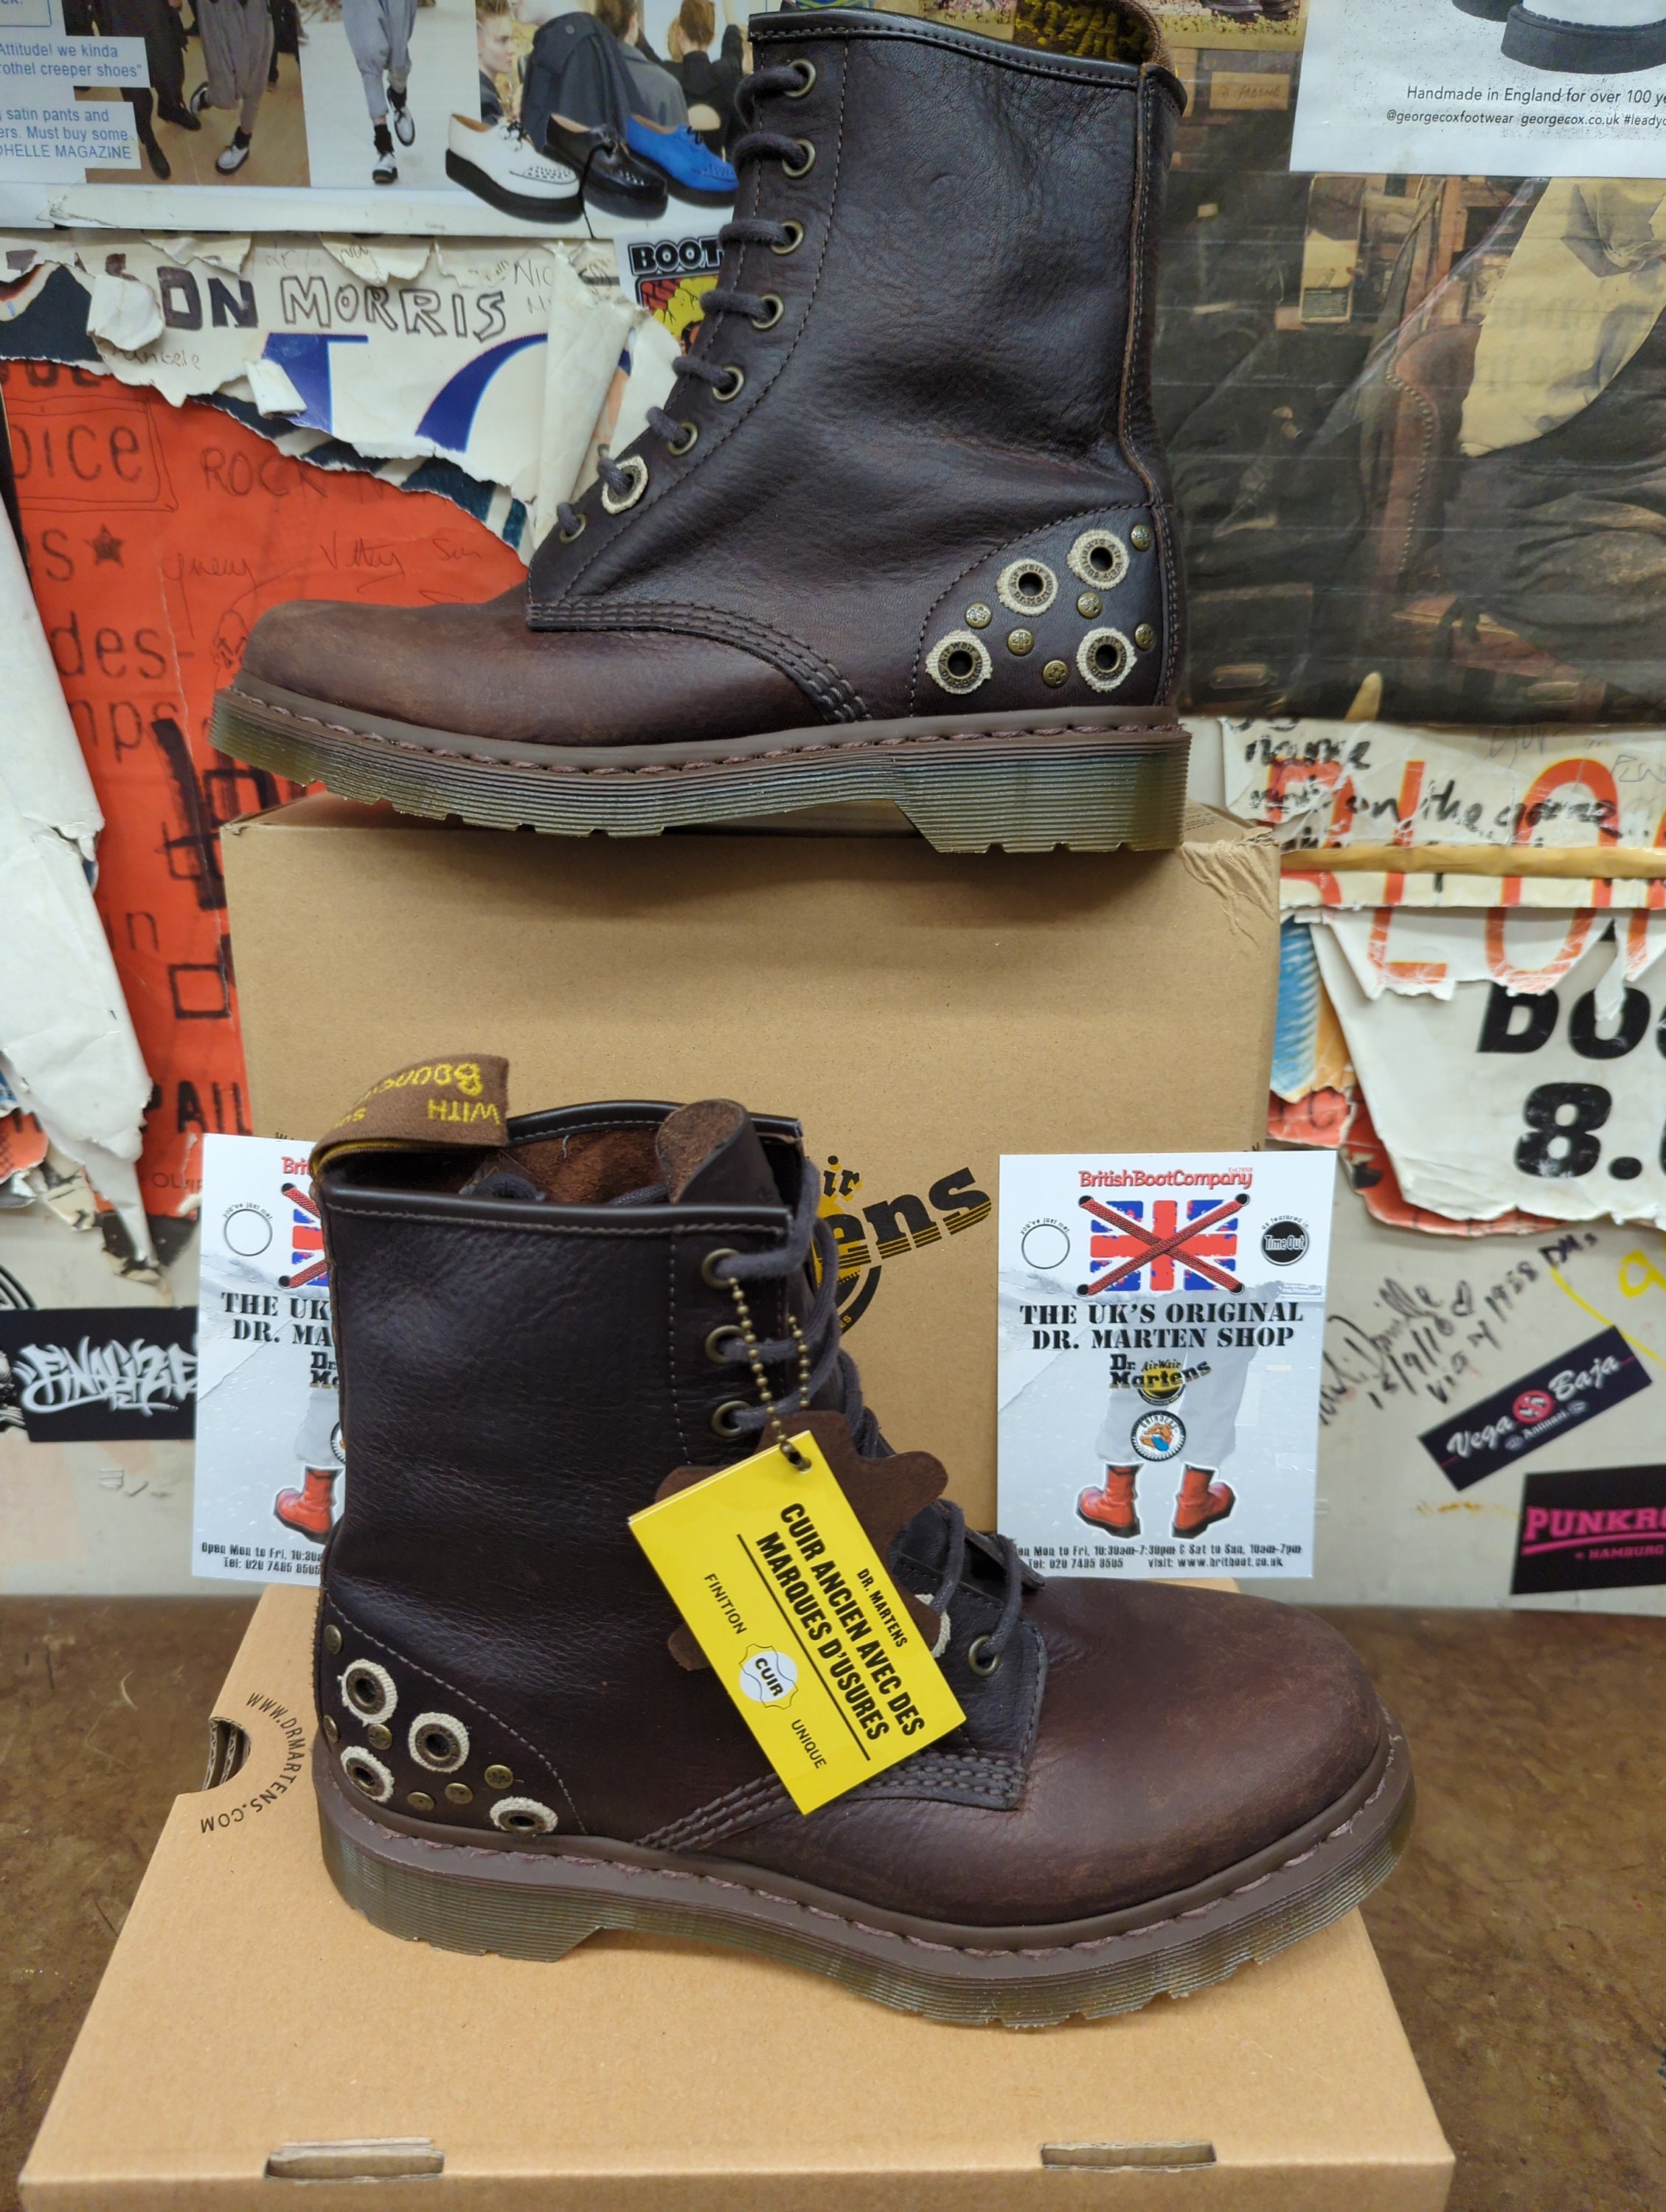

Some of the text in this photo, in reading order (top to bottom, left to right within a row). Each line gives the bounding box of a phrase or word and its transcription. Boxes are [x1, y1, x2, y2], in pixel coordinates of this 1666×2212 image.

[58, 47, 77, 56] we
[81, 44, 118, 58] kinda
[0, 63, 35, 75] othel
[41, 64, 91, 78] creeper
[1406, 86, 1482, 100] Handmade
[1487, 87, 1499, 101] in
[1504, 88, 1561, 105] England
[1566, 88, 1586, 102] for
[1590, 92, 1622, 103] over
[1627, 89, 1652, 103] 100
[7, 108, 109, 122] satin pants and
[1386, 109, 1513, 124] @georgecoxfootwear
[1521, 111, 1620, 127] georgecox.co.uk
[27, 126, 59, 139] Must
[63, 127, 86, 142] buy
[55, 145, 132, 159] MAGAZINE
[280, 275, 508, 344] MORRIS
[427, 1098, 502, 1126] WITH
[1043, 1217, 1057, 1225] just
[1270, 1214, 1303, 1223] featured
[221, 1291, 279, 1316] THE
[1019, 1301, 1304, 1325] THE UK'S ORIGINAL
[232, 1318, 280, 1342] DR.
[1032, 1326, 1294, 1350] DR. MARTEN SHOP
[310, 1351, 337, 1370] Dr.
[1109, 1353, 1136, 1371] Dr.
[1108, 1360, 1212, 1389] Martens
[1445, 1415, 1514, 1460] Vega
[1547, 1355, 1621, 1402] Baja
[1524, 1506, 1666, 1542] PUNKR
[201, 1542, 226, 1554] Open
[230, 1544, 251, 1556] Mon
[255, 1548, 265, 1557] to
[1034, 1545, 1055, 1556] Mon
[1059, 1545, 1069, 1556] to
[1189, 1544, 1207, 1555] Sat
[1211, 1543, 1221, 1554] to
[224, 1557, 242, 1568] Tel:
[246, 1560, 264, 1571] 020
[1049, 1558, 1067, 1568] 020
[1148, 1556, 1283, 1568] visit: www.britboot.co.uk
[704, 1572, 748, 1635] FINITION
[856, 1568, 909, 1649] DR. MARTENS
[780, 1502, 926, 1736] CUIR ANCIEN AVEC DES
[756, 1531, 890, 1741] MARQUES D'USURES
[754, 1657, 784, 1697] CUIR
[791, 1719, 827, 1770] UNIQUE
[200, 1692, 306, 1834] WWW.DRMARTENS.COM
